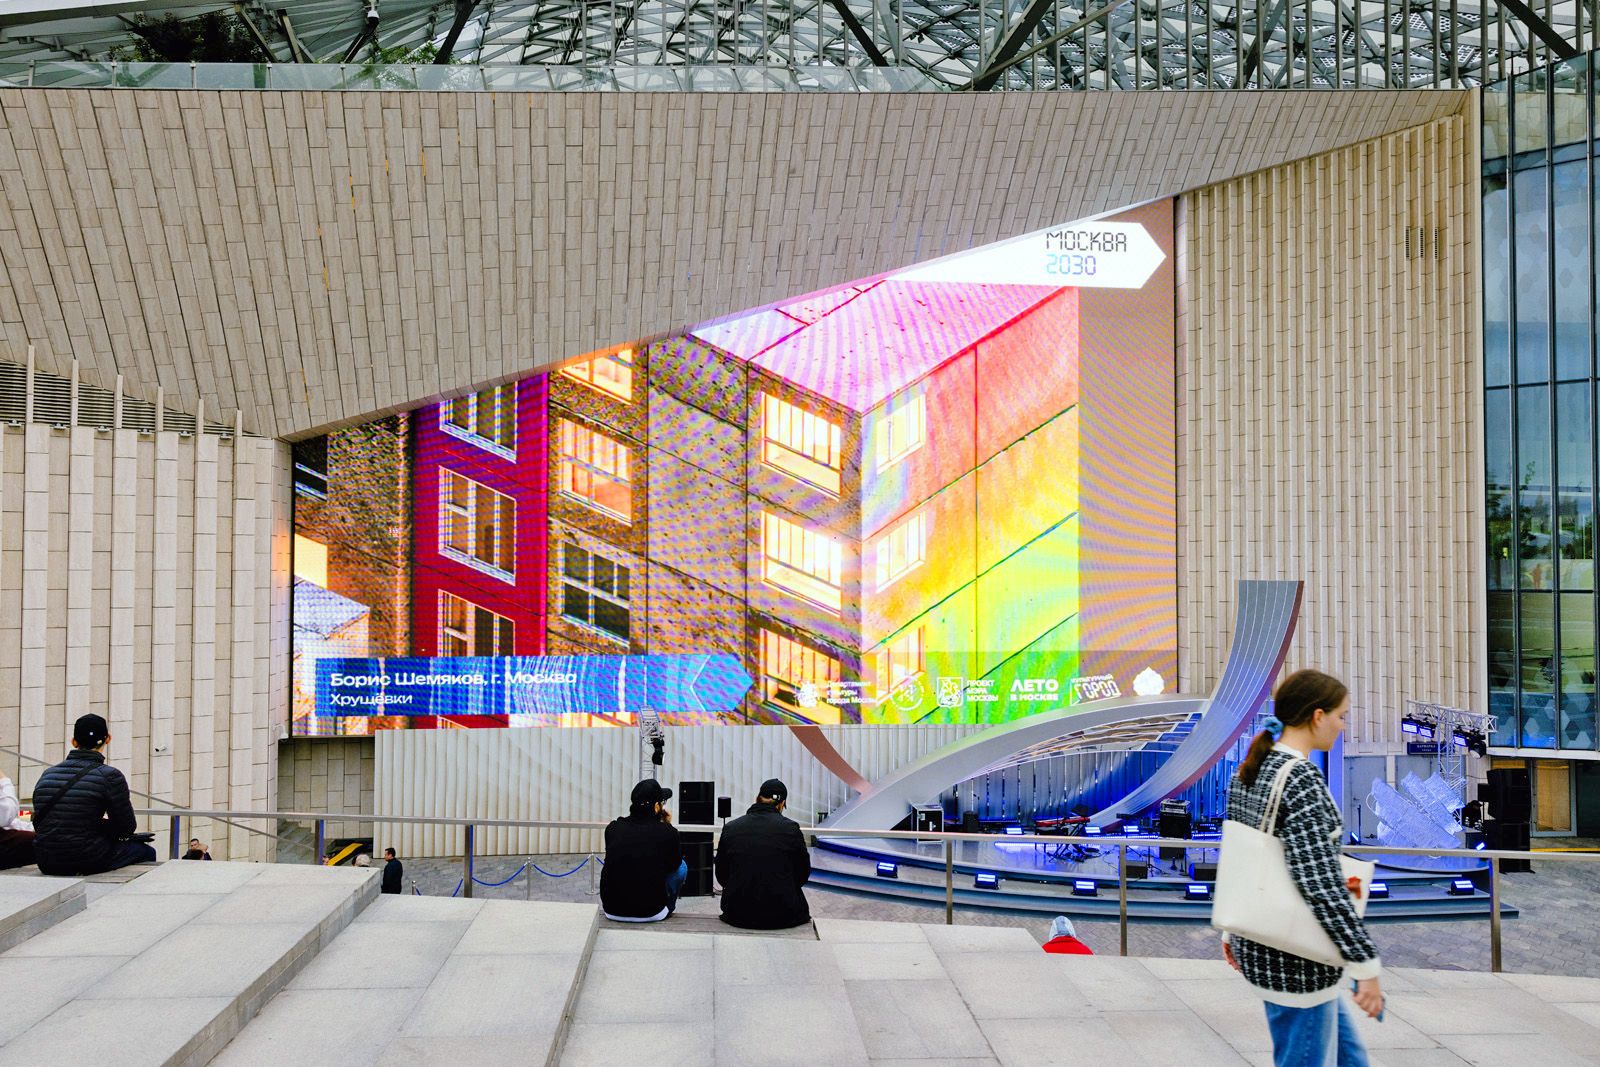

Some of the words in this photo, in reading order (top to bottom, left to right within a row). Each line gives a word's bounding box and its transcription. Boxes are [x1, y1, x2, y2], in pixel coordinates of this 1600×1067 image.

[1046, 231, 1126, 252] МОСКВА
[1046, 254, 1097, 276] 2030
[330, 673, 391, 687] Борис
[394, 673, 488, 687] Шемяков,
[491, 674, 501, 684] г.
[505, 672, 577, 684] Москва
[1010, 679, 1059, 692] ЛЕТО
[1073, 680, 1122, 700] ГОРОД
[330, 693, 413, 706] Хрущёвки
